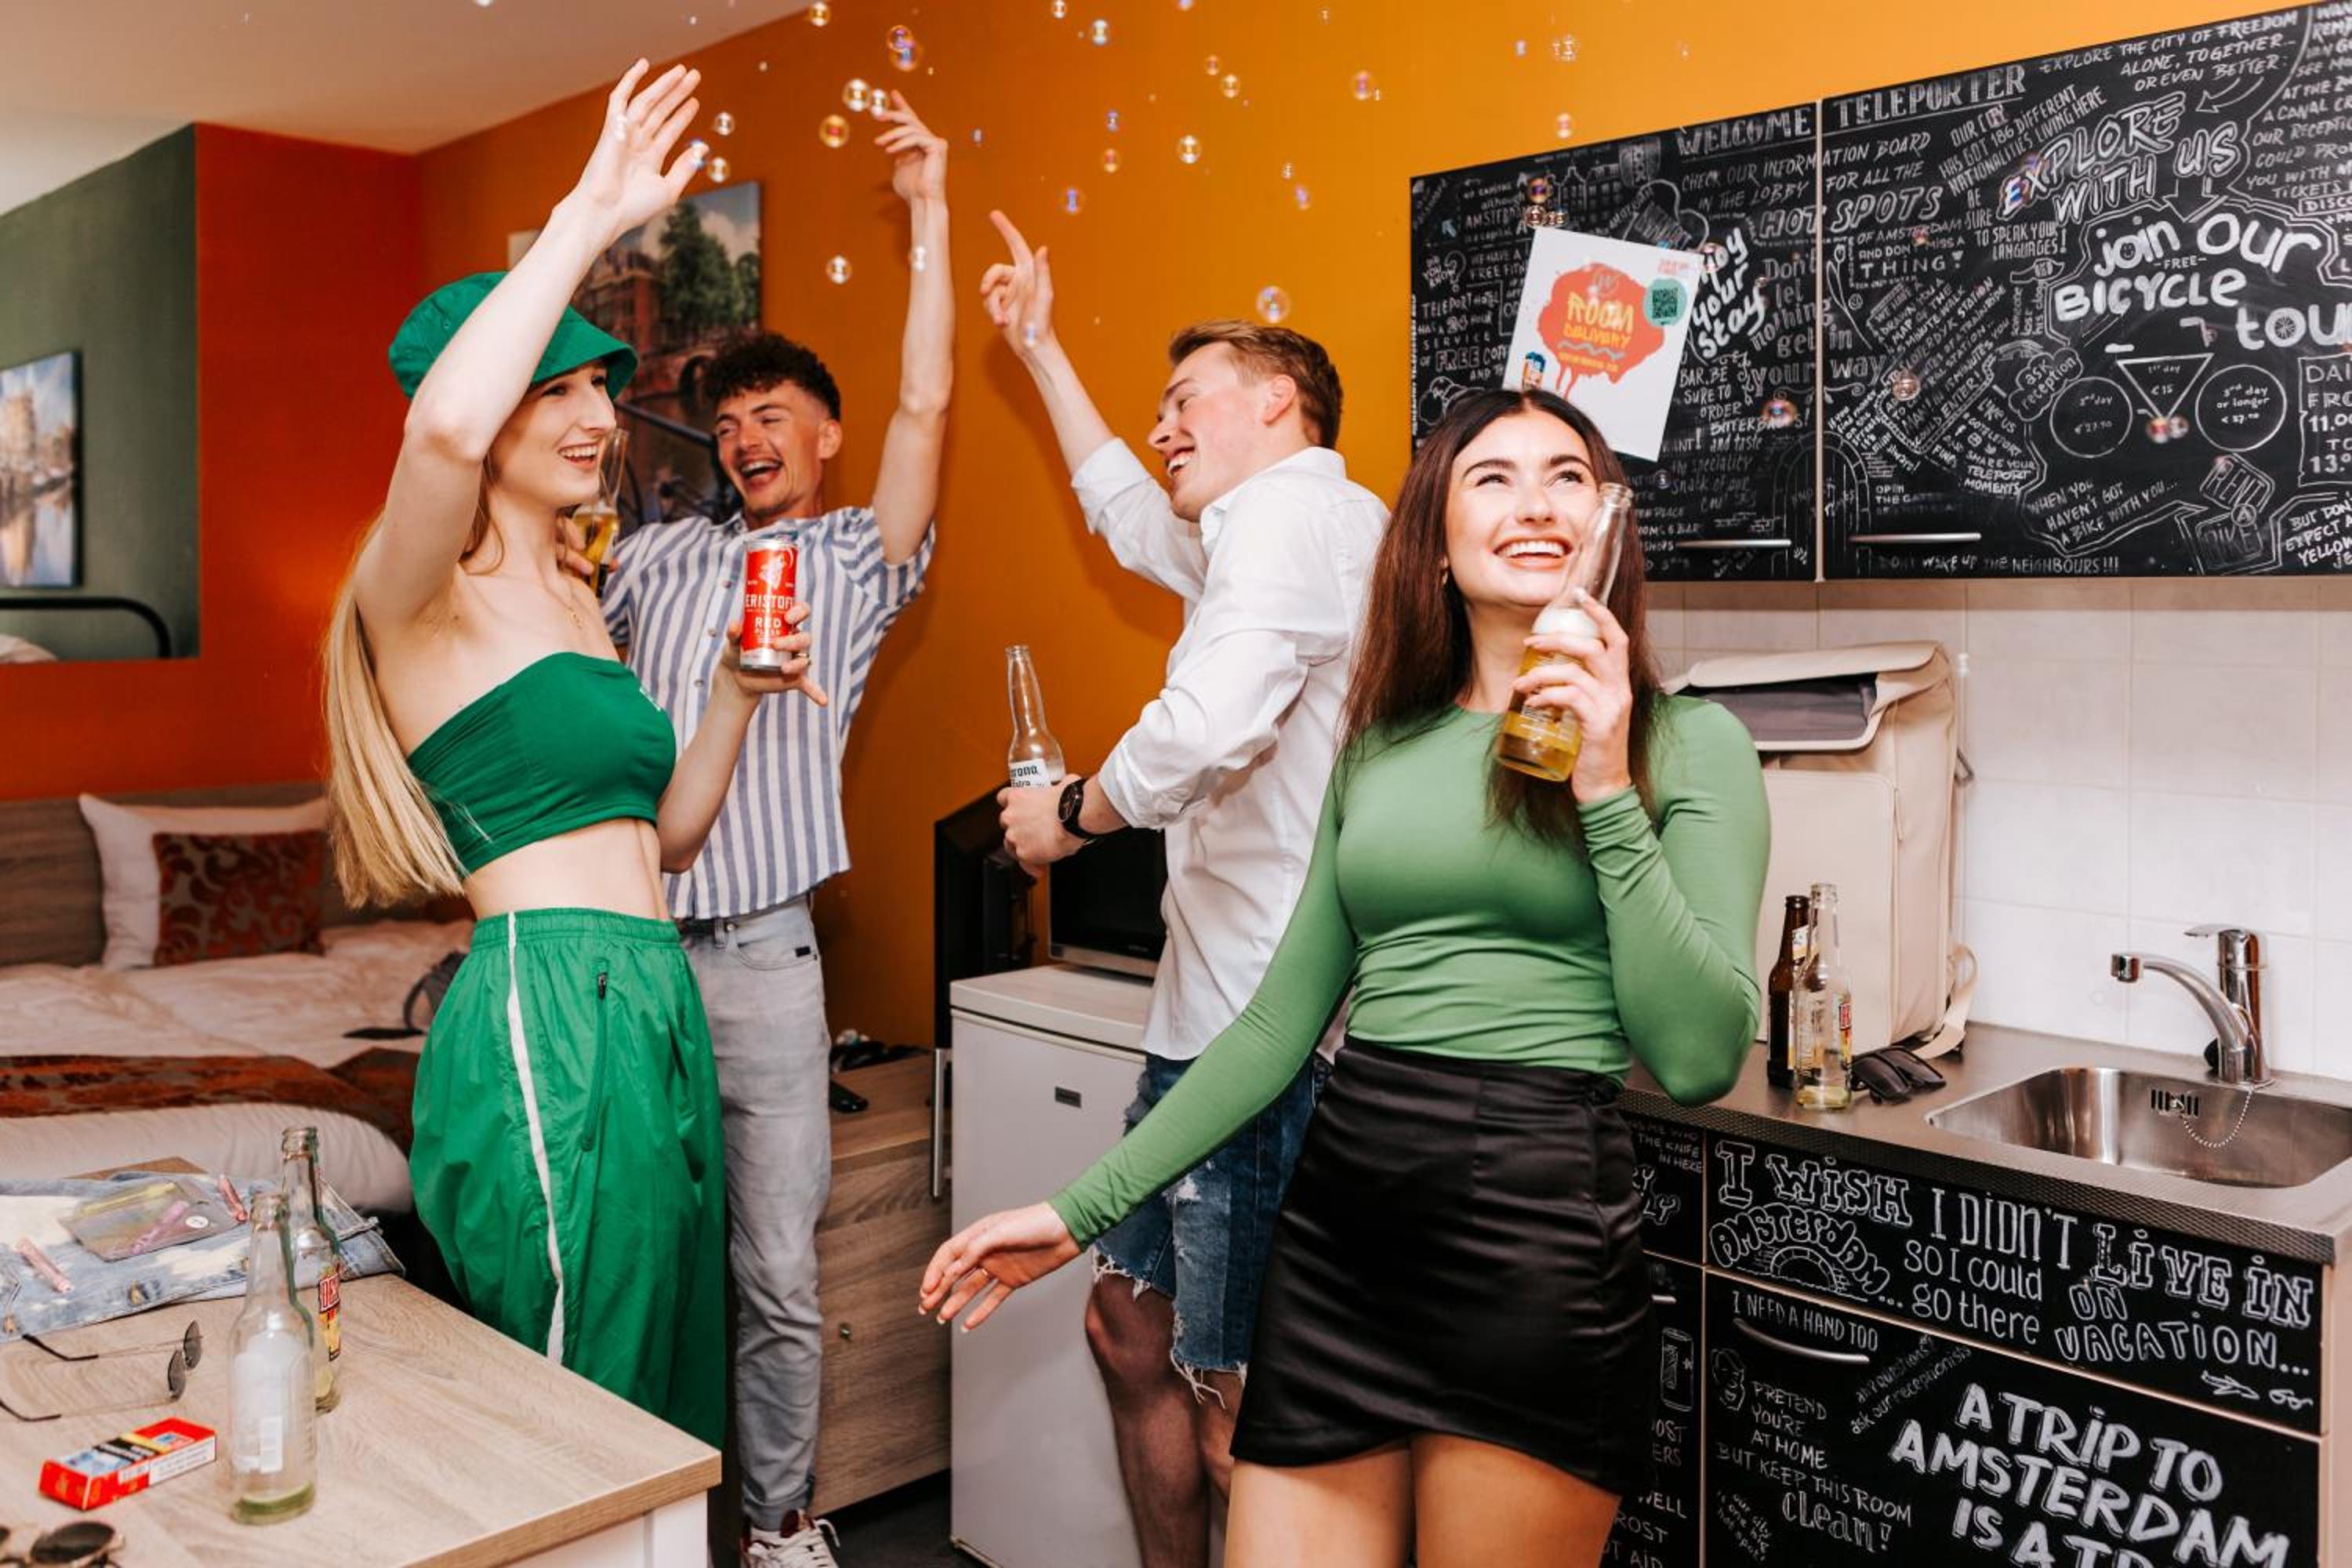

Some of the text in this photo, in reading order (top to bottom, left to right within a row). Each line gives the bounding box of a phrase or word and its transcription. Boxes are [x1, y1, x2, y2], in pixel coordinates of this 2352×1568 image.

[2040, 46, 2114, 74] EXPLORE
[2120, 39, 2147, 56] THE
[2192, 28, 2212, 45] OF
[2216, 10, 2298, 41] FREEDOM
[1833, 64, 2027, 129] TELEPORTER
[2134, 75, 2156, 92] OR
[2160, 68, 2205, 88] EVEN
[2281, 84, 2302, 100] AT
[2071, 85, 2107, 125] HERE
[2262, 98, 2328, 123] A CANAL
[1676, 106, 1811, 156] WELCOME
[1951, 121, 1977, 147] OUR
[2172, 121, 2240, 178] US
[2252, 115, 2352, 147] OUR RECEPTIO
[1681, 169, 1721, 192] CHECK
[1726, 163, 1762, 187] OUR
[1872, 131, 1931, 161] BOARD
[1938, 154, 1964, 180] HAS
[1965, 140, 1988, 169] GOT
[1990, 125, 2015, 148] 186
[1996, 90, 2187, 221] EXPLORE
[2255, 145, 2307, 169] COULD
[1719, 191, 1745, 209] THE
[1749, 180, 1810, 207] LOBBY
[1825, 172, 1859, 194] FOR
[1862, 166, 1891, 187] ALL
[1893, 159, 1926, 181] THE
[2246, 173, 2278, 191] YOU
[1830, 185, 1944, 234] SPOTS
[1965, 208, 1993, 230] SURE
[1973, 229, 1990, 247] TO
[1992, 224, 2029, 245] SPEAK
[2093, 215, 2181, 277] join
[1566, 289, 1635, 334] ROOM
[1692, 261, 1749, 332] your
[1563, 321, 1632, 351] DELIVERY
[1697, 280, 1766, 359] stay
[1436, 346, 1481, 372] FREE
[1829, 354, 1887, 387] way
[2025, 358, 2055, 386] ask
[2306, 366, 2352, 383] DAI
[1684, 383, 1732, 405] SURE TO
[2020, 357, 2078, 410] reception
[1700, 401, 1743, 422] ORDER
[1964, 477, 2020, 496] MOMENTS
[1967, 464, 2032, 481] TELEPORT
[2102, 482, 2127, 503] GOT
[2205, 456, 2266, 508] RENT
[2027, 479, 2094, 515] WHEN YOU
[2288, 491, 2352, 531] BUT DON'
[2060, 531, 2071, 546] A
[2285, 520, 2341, 551] EXPECT
[755, 616, 782, 628] RD
[1715, 1138, 1755, 1209] I
[1930, 1187, 1947, 1240] I
[1947, 1247, 1962, 1283] I
[1966, 1255, 2042, 1301] could
[1911, 1283, 2041, 1345] go there
[2068, 1279, 2129, 1322] ON
[1733, 1290, 1878, 1352] I NEED A HAND TOO
[1750, 1381, 1828, 1421] PRETEND
[1750, 1403, 1806, 1437] YOU'RE
[1849, 1410, 1875, 1435] ask
[1871, 1394, 1893, 1419] our
[1751, 1429, 1828, 1470] AT HOME
[1955, 1381, 1993, 1432] A
[2148, 1437, 2223, 1503] TO
[1717, 1442, 1912, 1526] BUT KEEP THIS ROOM
[1888, 1418, 2291, 1568] AMSTERDAM
[1951, 1497, 2004, 1552] IS
